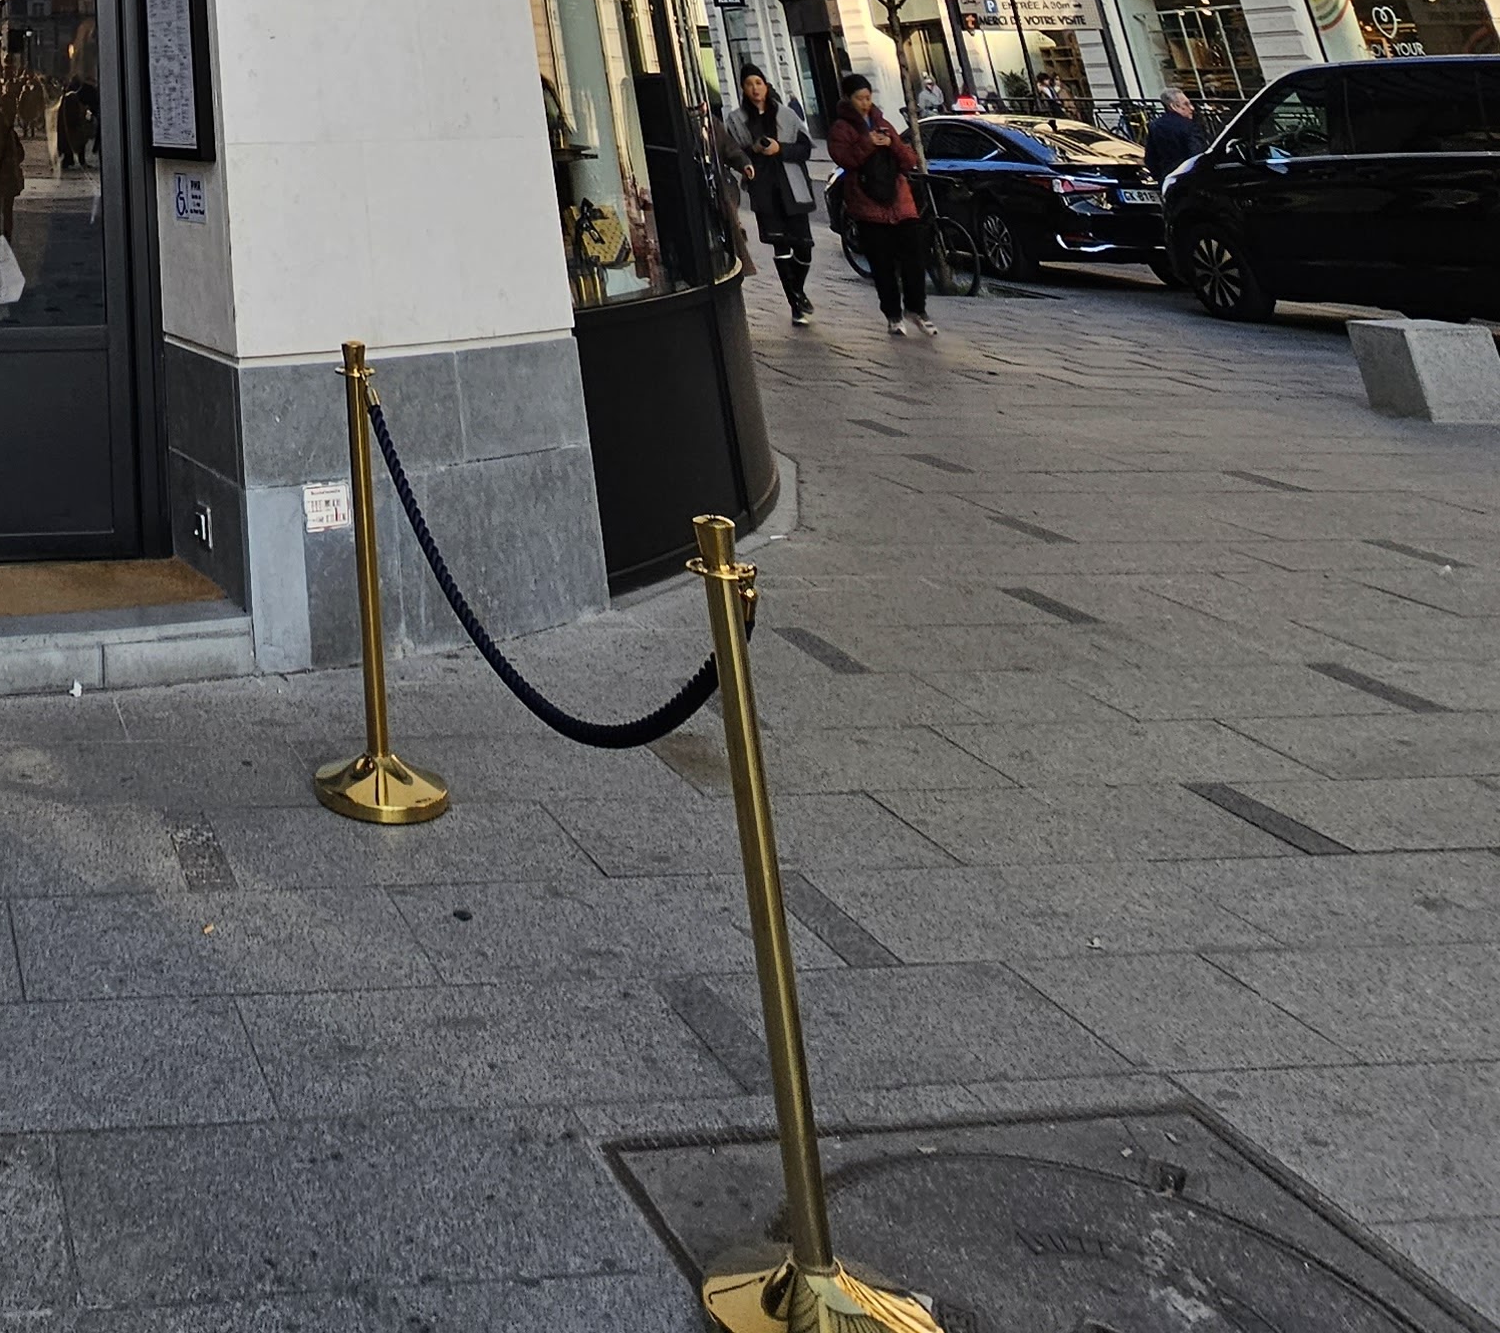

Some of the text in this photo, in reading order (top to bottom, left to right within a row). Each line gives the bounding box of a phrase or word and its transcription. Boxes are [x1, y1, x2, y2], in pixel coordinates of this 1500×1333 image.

[1024, 15, 1056, 25] VOTRE
[1060, 15, 1087, 25] VISITE
[1393, 42, 1427, 56] YOUR
